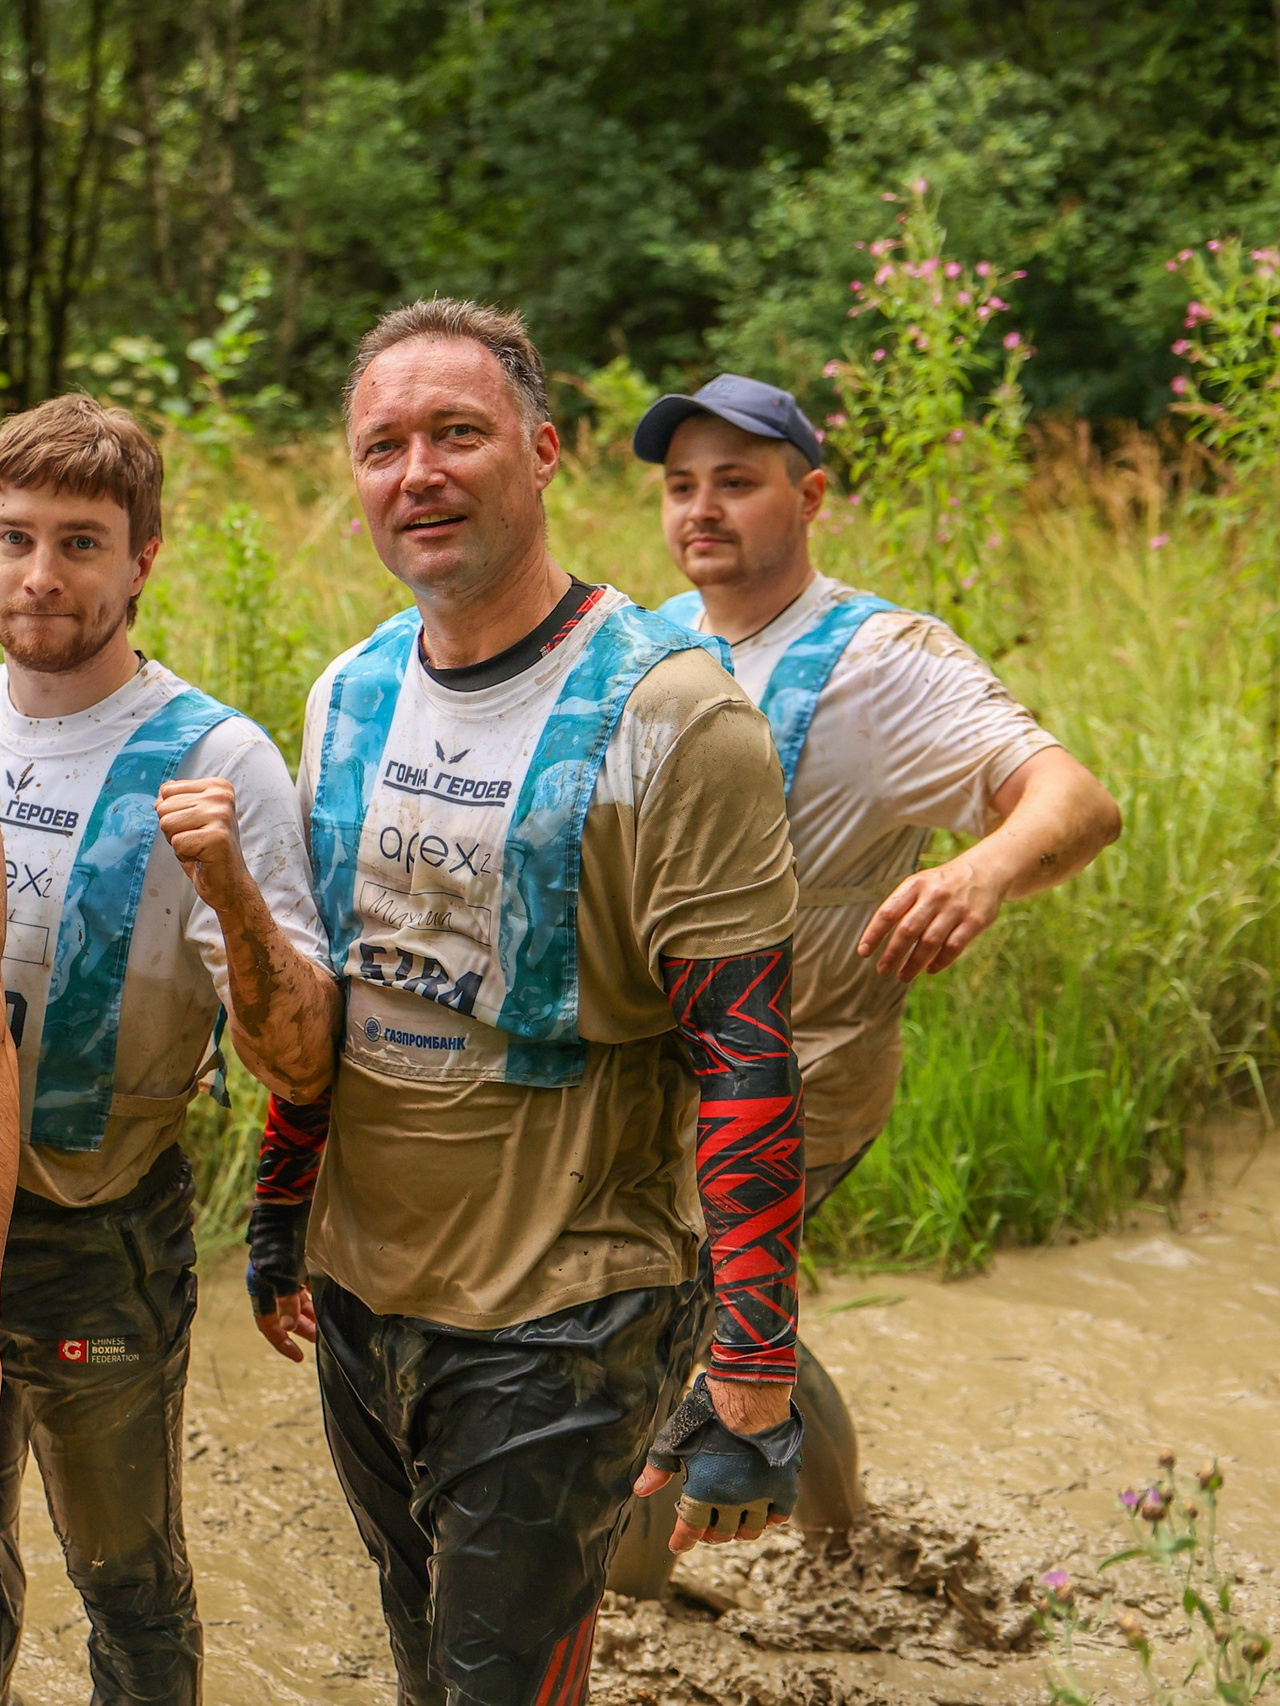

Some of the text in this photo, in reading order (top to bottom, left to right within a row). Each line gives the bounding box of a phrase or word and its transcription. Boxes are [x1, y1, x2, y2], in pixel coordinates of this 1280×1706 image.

[433, 772, 512, 799] ГЕРОЕВ
[5, 799, 79, 829] ГЕРОЕВ
[384, 1027, 467, 1051] ГАЗПРОМБАНК
[91, 1337, 126, 1346] CHINESE
[91, 1345, 126, 1354] BOXING
[91, 1353, 140, 1363] FEDERATION
